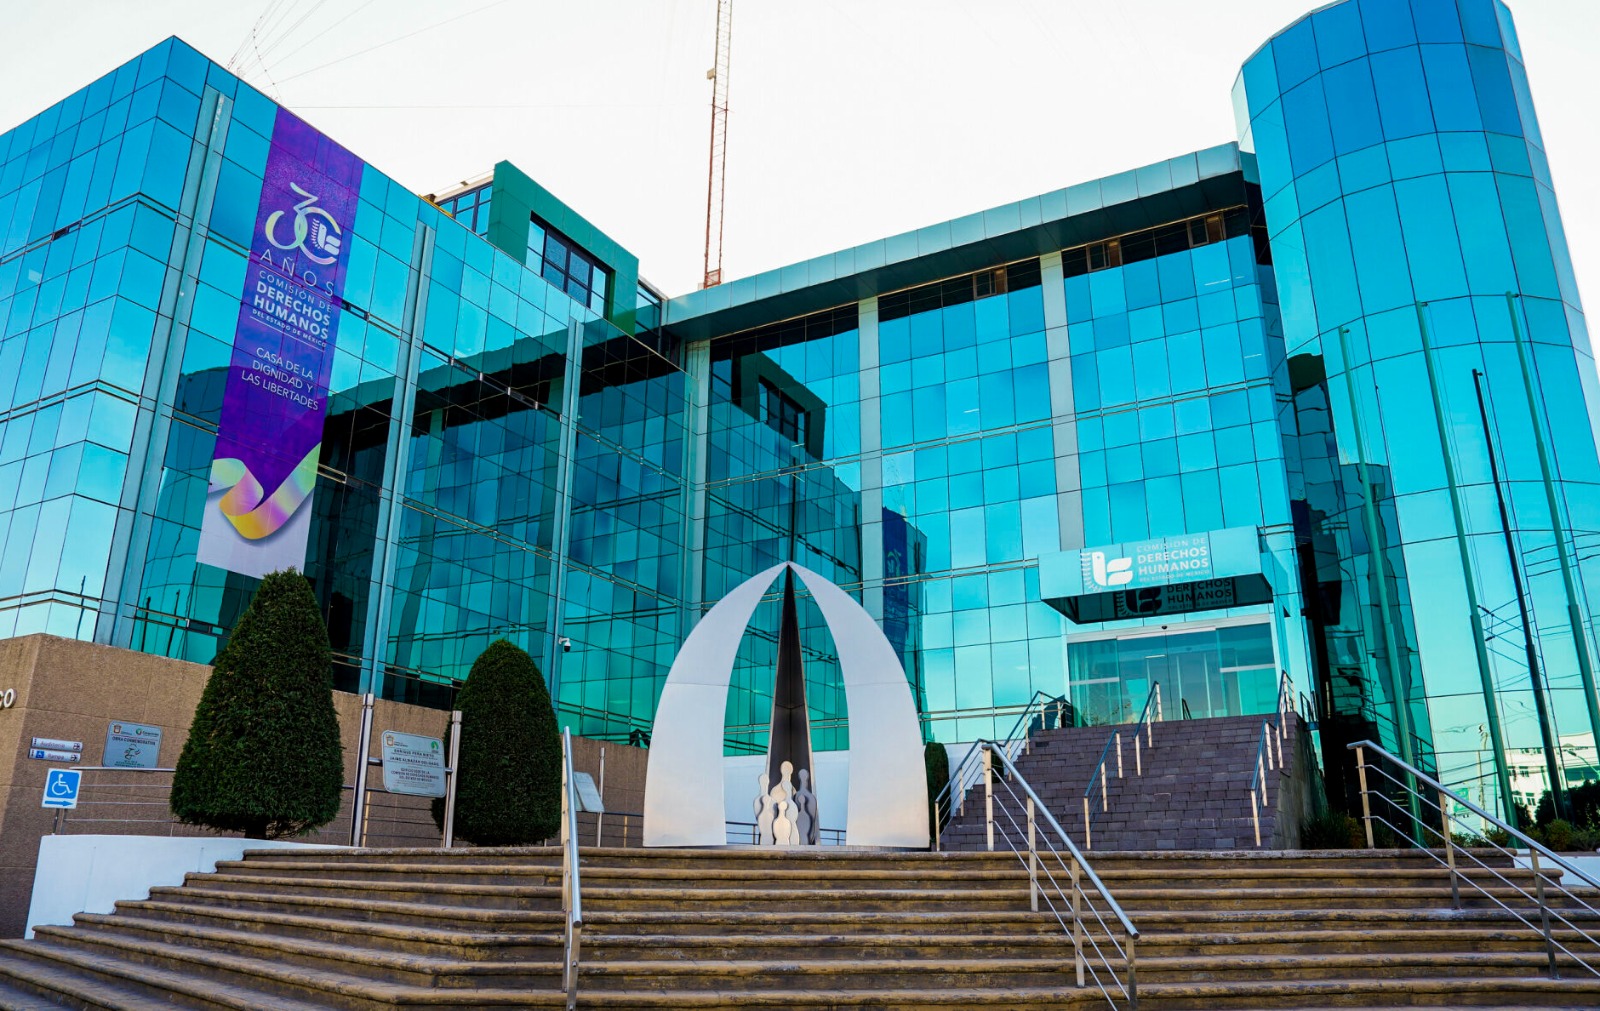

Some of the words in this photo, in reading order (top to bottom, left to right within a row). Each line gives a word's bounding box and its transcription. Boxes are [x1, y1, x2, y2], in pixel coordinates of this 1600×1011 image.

[260, 249, 334, 296] AÑOS
[260, 270, 315, 304] COMISIÓN
[319, 301, 332, 313] DE
[253, 294, 328, 339] HUMANOS
[256, 281, 331, 326] DERECHOS
[252, 308, 264, 319] DEL
[266, 314, 290, 331] ESTADO
[292, 328, 301, 336] DE
[303, 332, 327, 347] MÉXICO
[252, 360, 303, 389] DIGNIDAD
[307, 383, 313, 393] Y
[256, 347, 283, 367] CASA
[285, 360, 299, 374] DE
[301, 367, 313, 380] LA
[241, 370, 261, 386] LAS
[262, 379, 319, 411] LIBERTADES
[1137, 546, 1207, 564] DERECHOS
[1192, 537, 1205, 545] DE
[1139, 558, 1209, 575] HUMANOS
